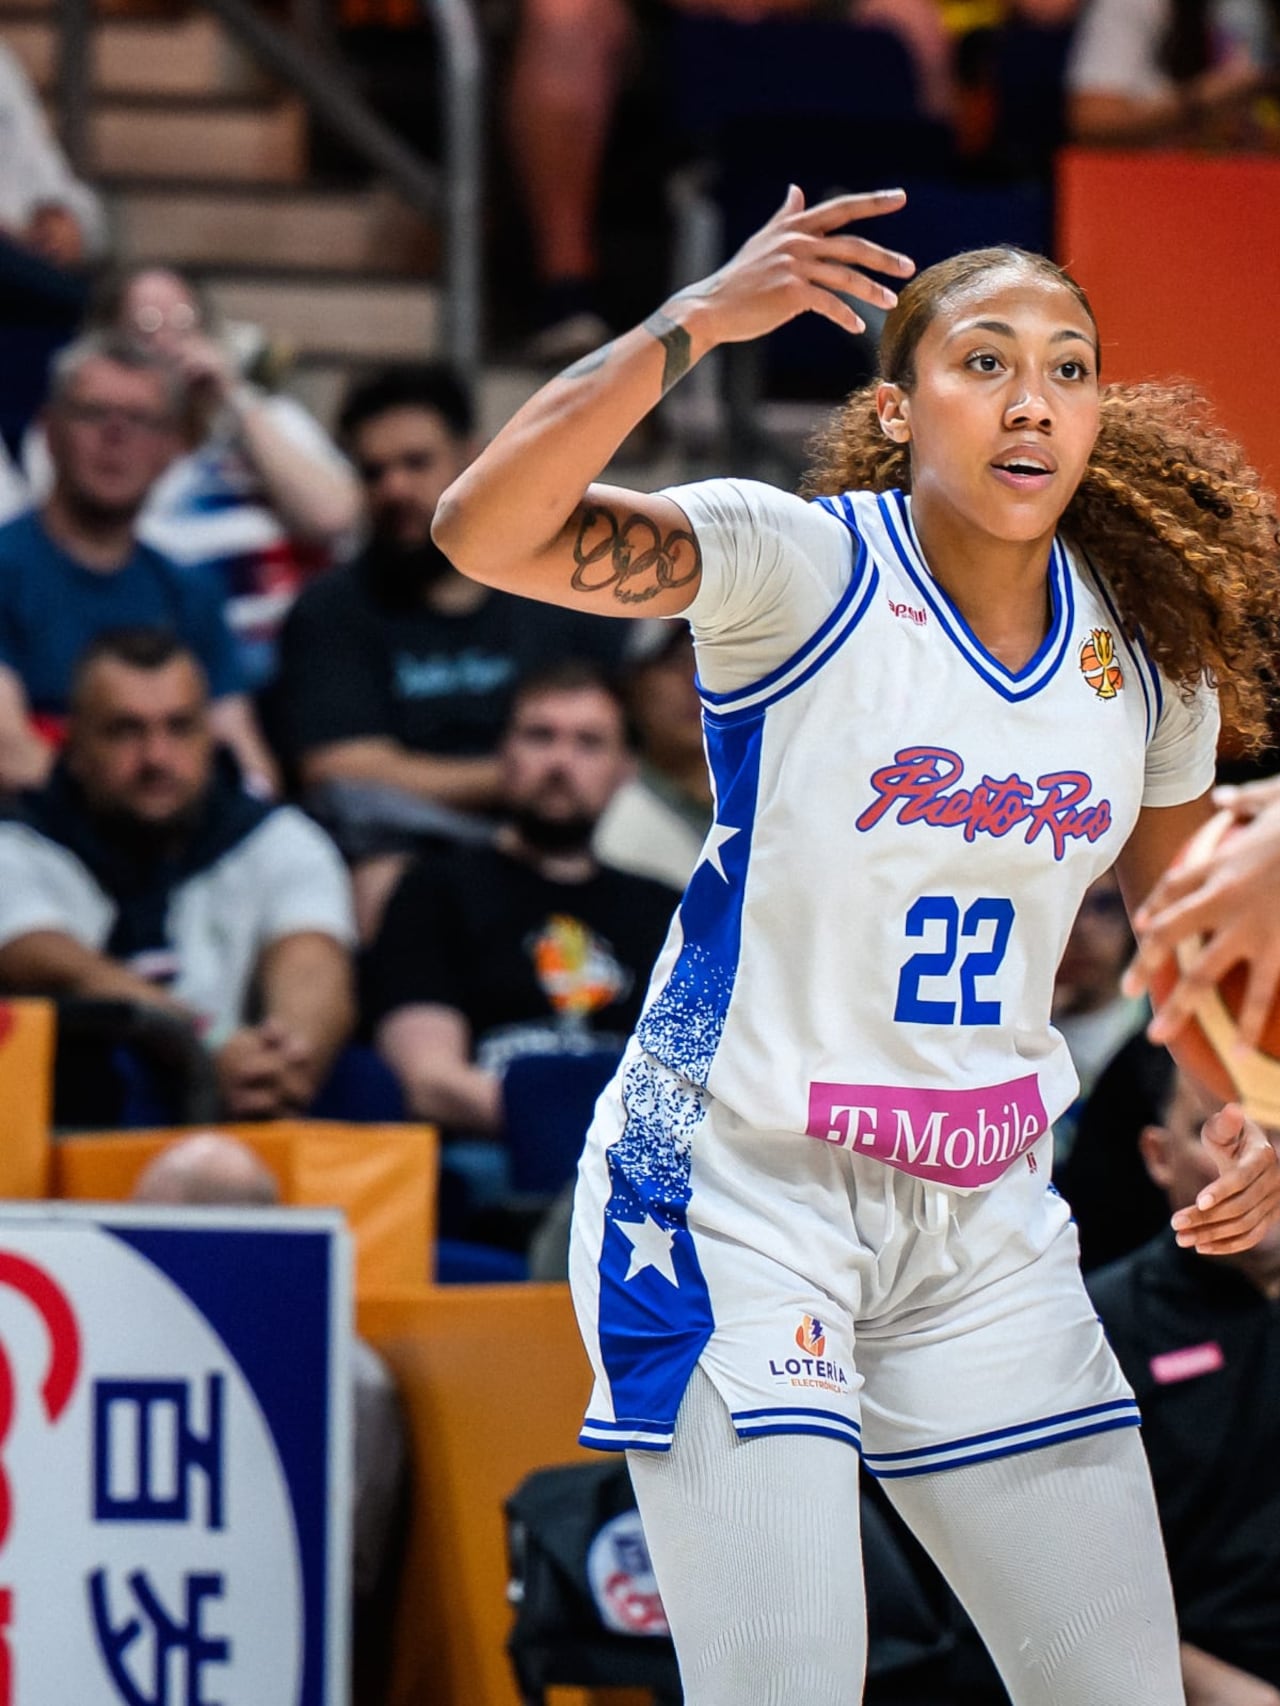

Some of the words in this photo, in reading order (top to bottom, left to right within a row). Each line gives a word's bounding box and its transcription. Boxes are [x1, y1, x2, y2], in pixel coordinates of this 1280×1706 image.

[855, 745, 1033, 842] Puerto
[1024, 770, 1112, 860] Rico
[893, 895, 1016, 1026] 22
